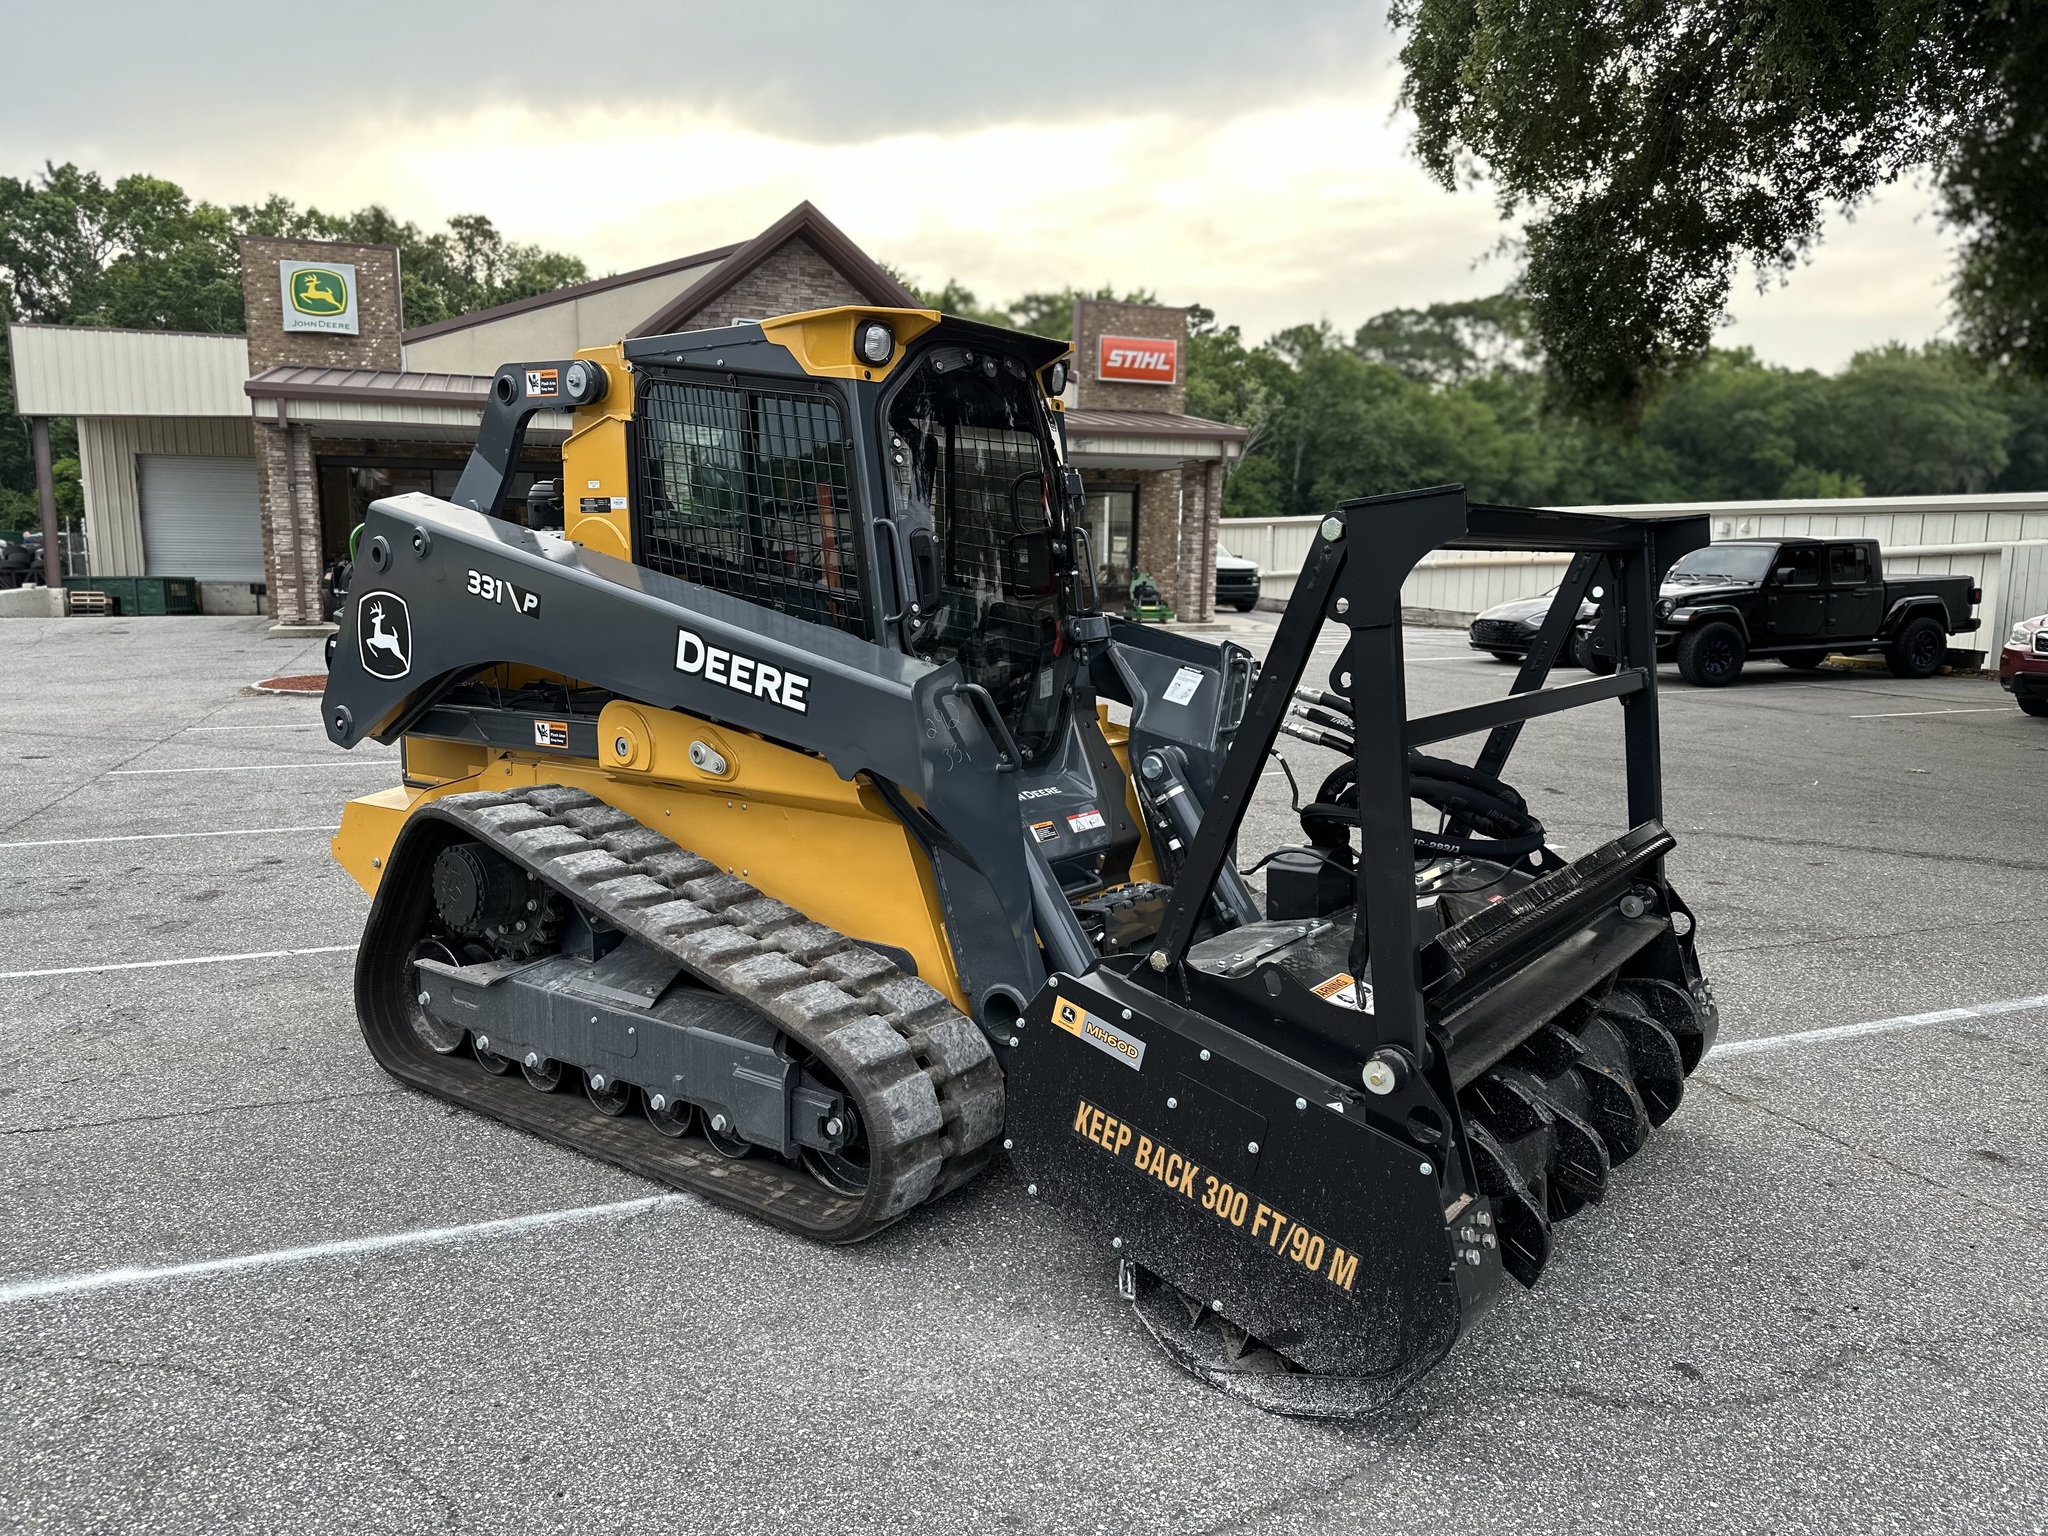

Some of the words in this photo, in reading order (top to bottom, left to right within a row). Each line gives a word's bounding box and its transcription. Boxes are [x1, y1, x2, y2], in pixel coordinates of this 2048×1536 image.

[318, 320, 350, 330] DEERE
[1106, 349, 1171, 371] STIHL
[675, 629, 809, 713] DEERE
[1022, 786, 1062, 800] DEERE
[1315, 979, 1348, 997] ARNING
[1085, 1021, 1139, 1059] MH60D
[1074, 1100, 1132, 1156] KEEP
[1135, 1135, 1199, 1199] BACK
[1201, 1175, 1249, 1227] 300
[1251, 1203, 1325, 1271] FT/90
[1328, 1247, 1359, 1291] M
